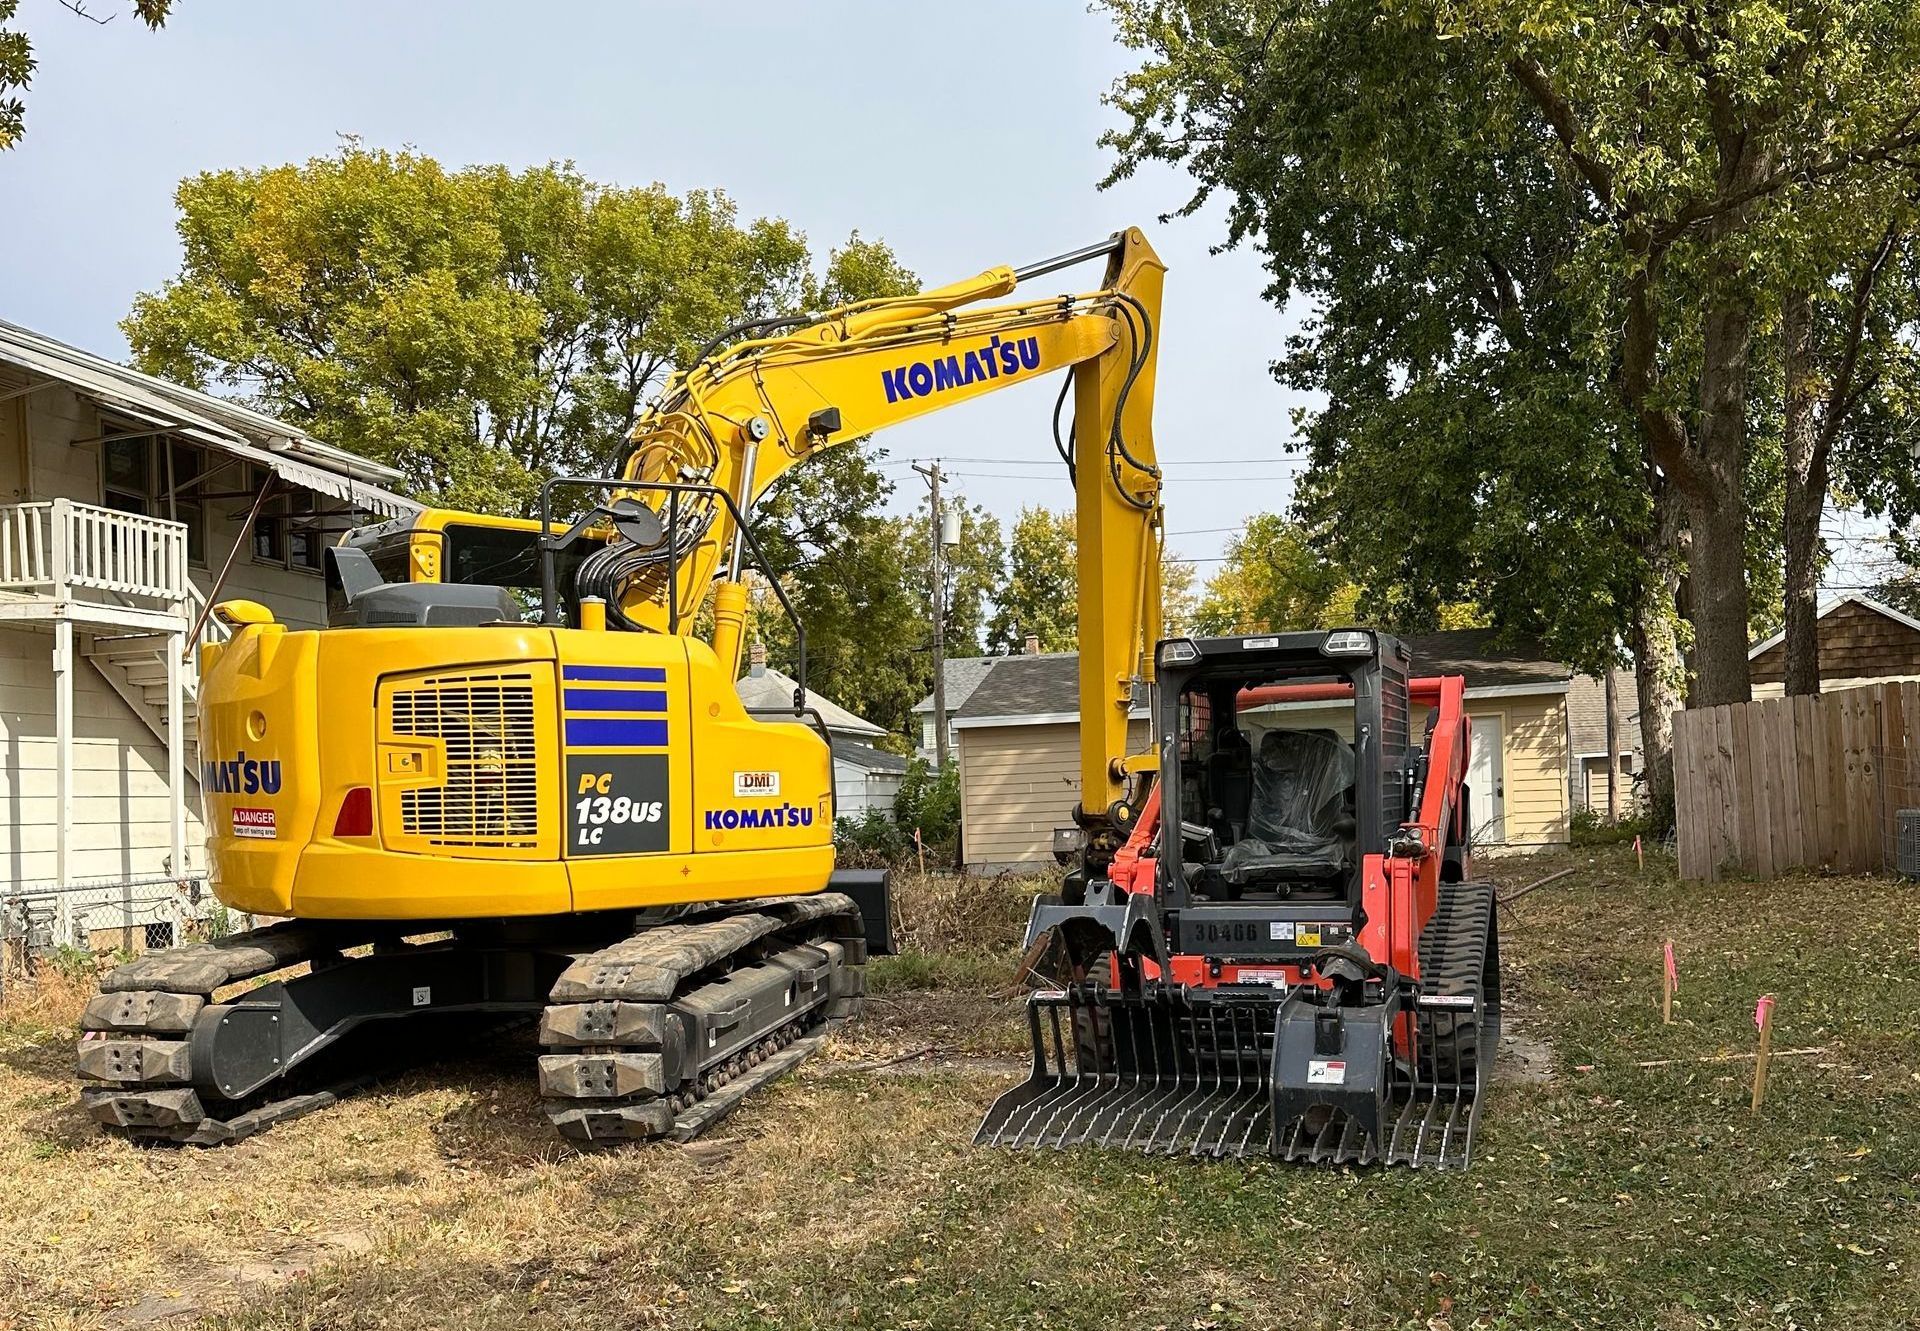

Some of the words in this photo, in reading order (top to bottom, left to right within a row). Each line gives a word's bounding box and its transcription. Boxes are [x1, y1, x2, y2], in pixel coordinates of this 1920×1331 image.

[881, 335, 1041, 404] KOMATSU
[205, 751, 281, 795] MATSU
[578, 773, 613, 795] PC
[744, 773, 770, 788] DMI
[240, 811, 275, 824] DANGER
[576, 796, 663, 825] 138US
[705, 802, 813, 830] KOMATSU
[250, 828, 264, 836] swing
[578, 827, 604, 845] LC
